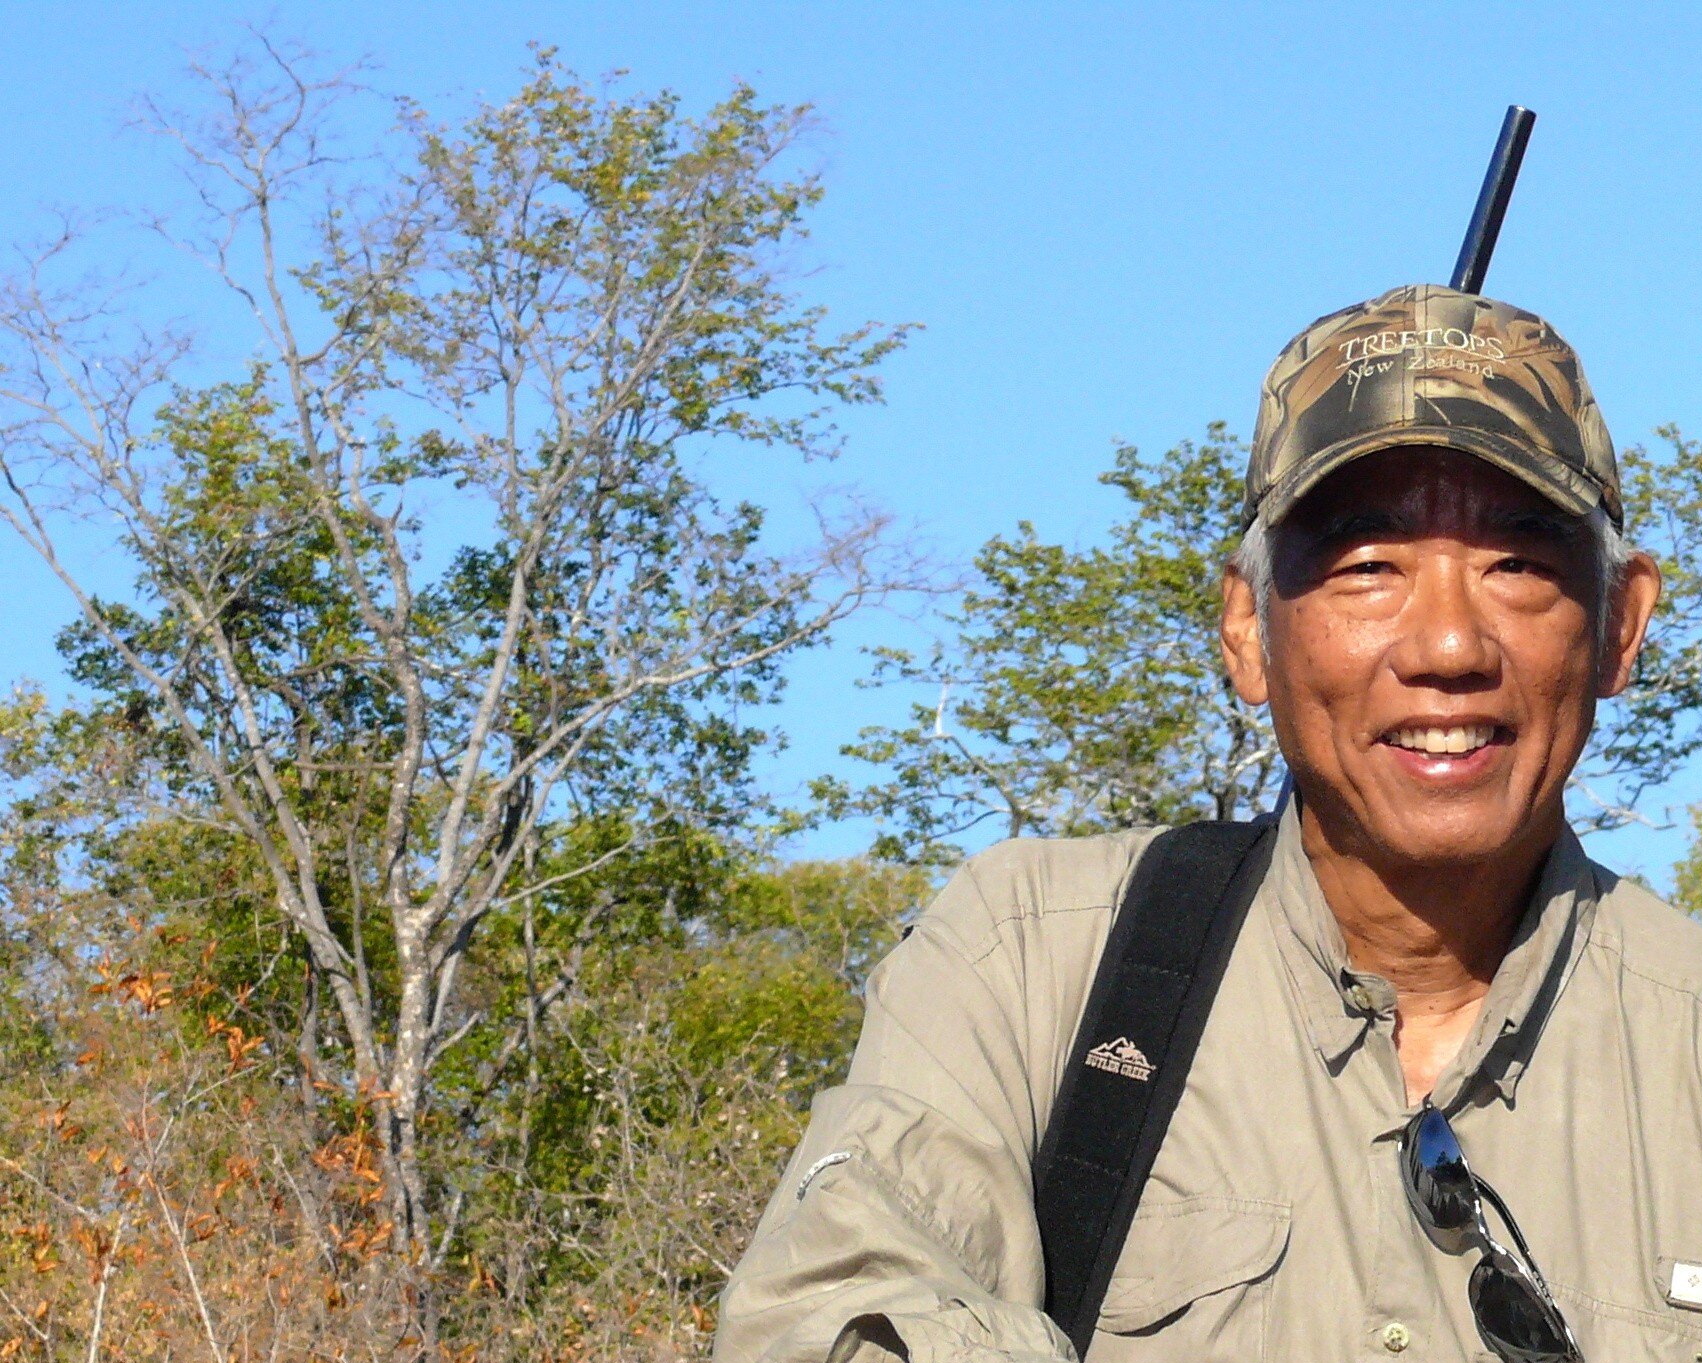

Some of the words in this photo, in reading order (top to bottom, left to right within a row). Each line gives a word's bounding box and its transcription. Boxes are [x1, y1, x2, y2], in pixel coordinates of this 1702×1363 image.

[1338, 328, 1504, 360] TREETOPS
[1347, 360, 1394, 385] New
[1406, 354, 1495, 379] Zealand
[1085, 1054, 1119, 1073] BUTLER
[1120, 1063, 1151, 1081] CREEK
